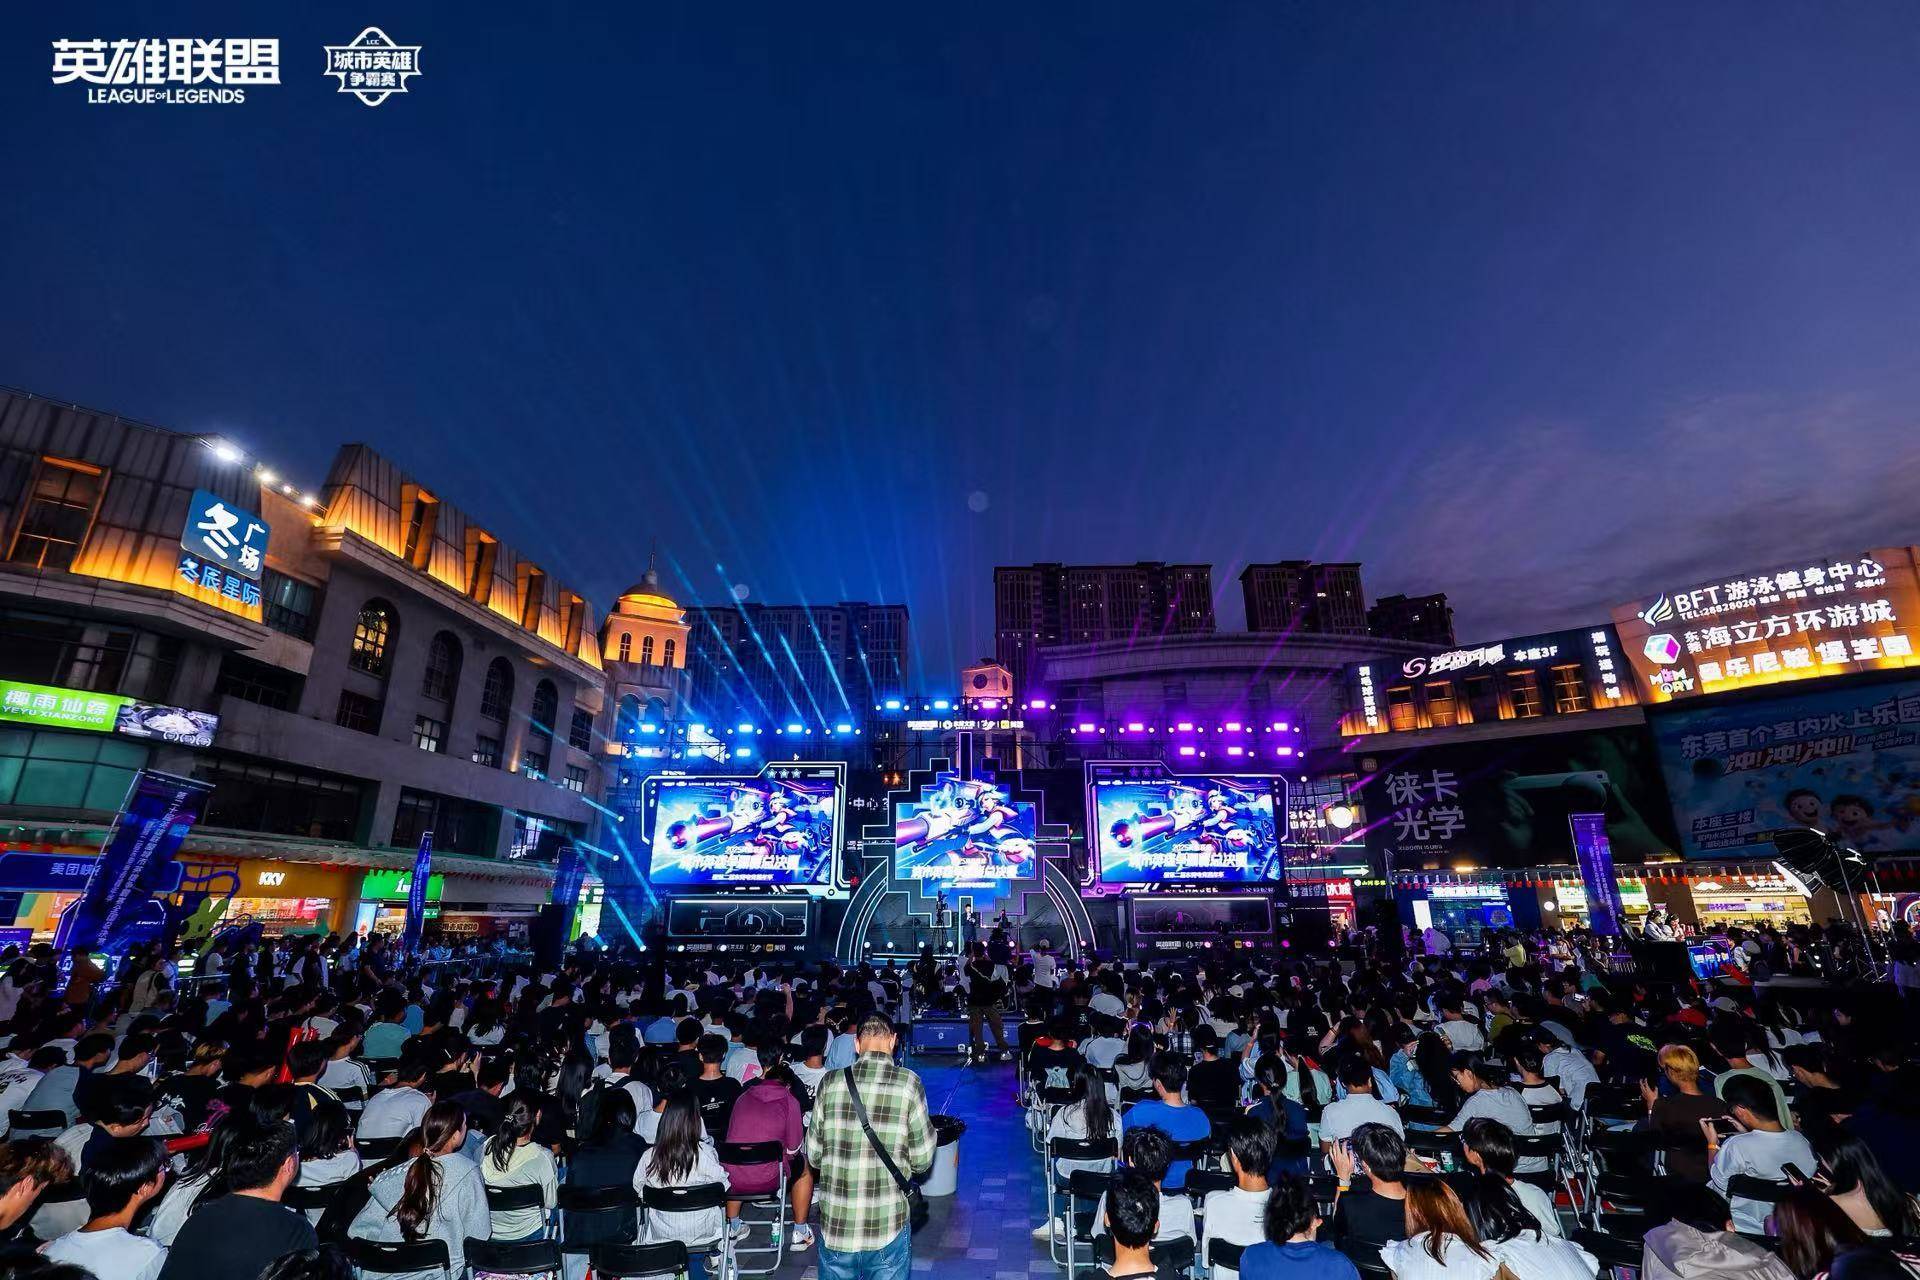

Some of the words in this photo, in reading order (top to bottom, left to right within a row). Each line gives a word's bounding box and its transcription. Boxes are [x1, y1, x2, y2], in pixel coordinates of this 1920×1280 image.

[239, 522, 266, 572] 广场
[178, 557, 261, 608] 冬辰星际
[1674, 585, 1721, 613] BFT
[1724, 558, 1885, 602] 游泳健身中心
[1702, 599, 1897, 650] 海立方环游城
[1384, 769, 1459, 806] 徕卡
[1394, 805, 1466, 841] 光学
[258, 872, 285, 886] KKV
